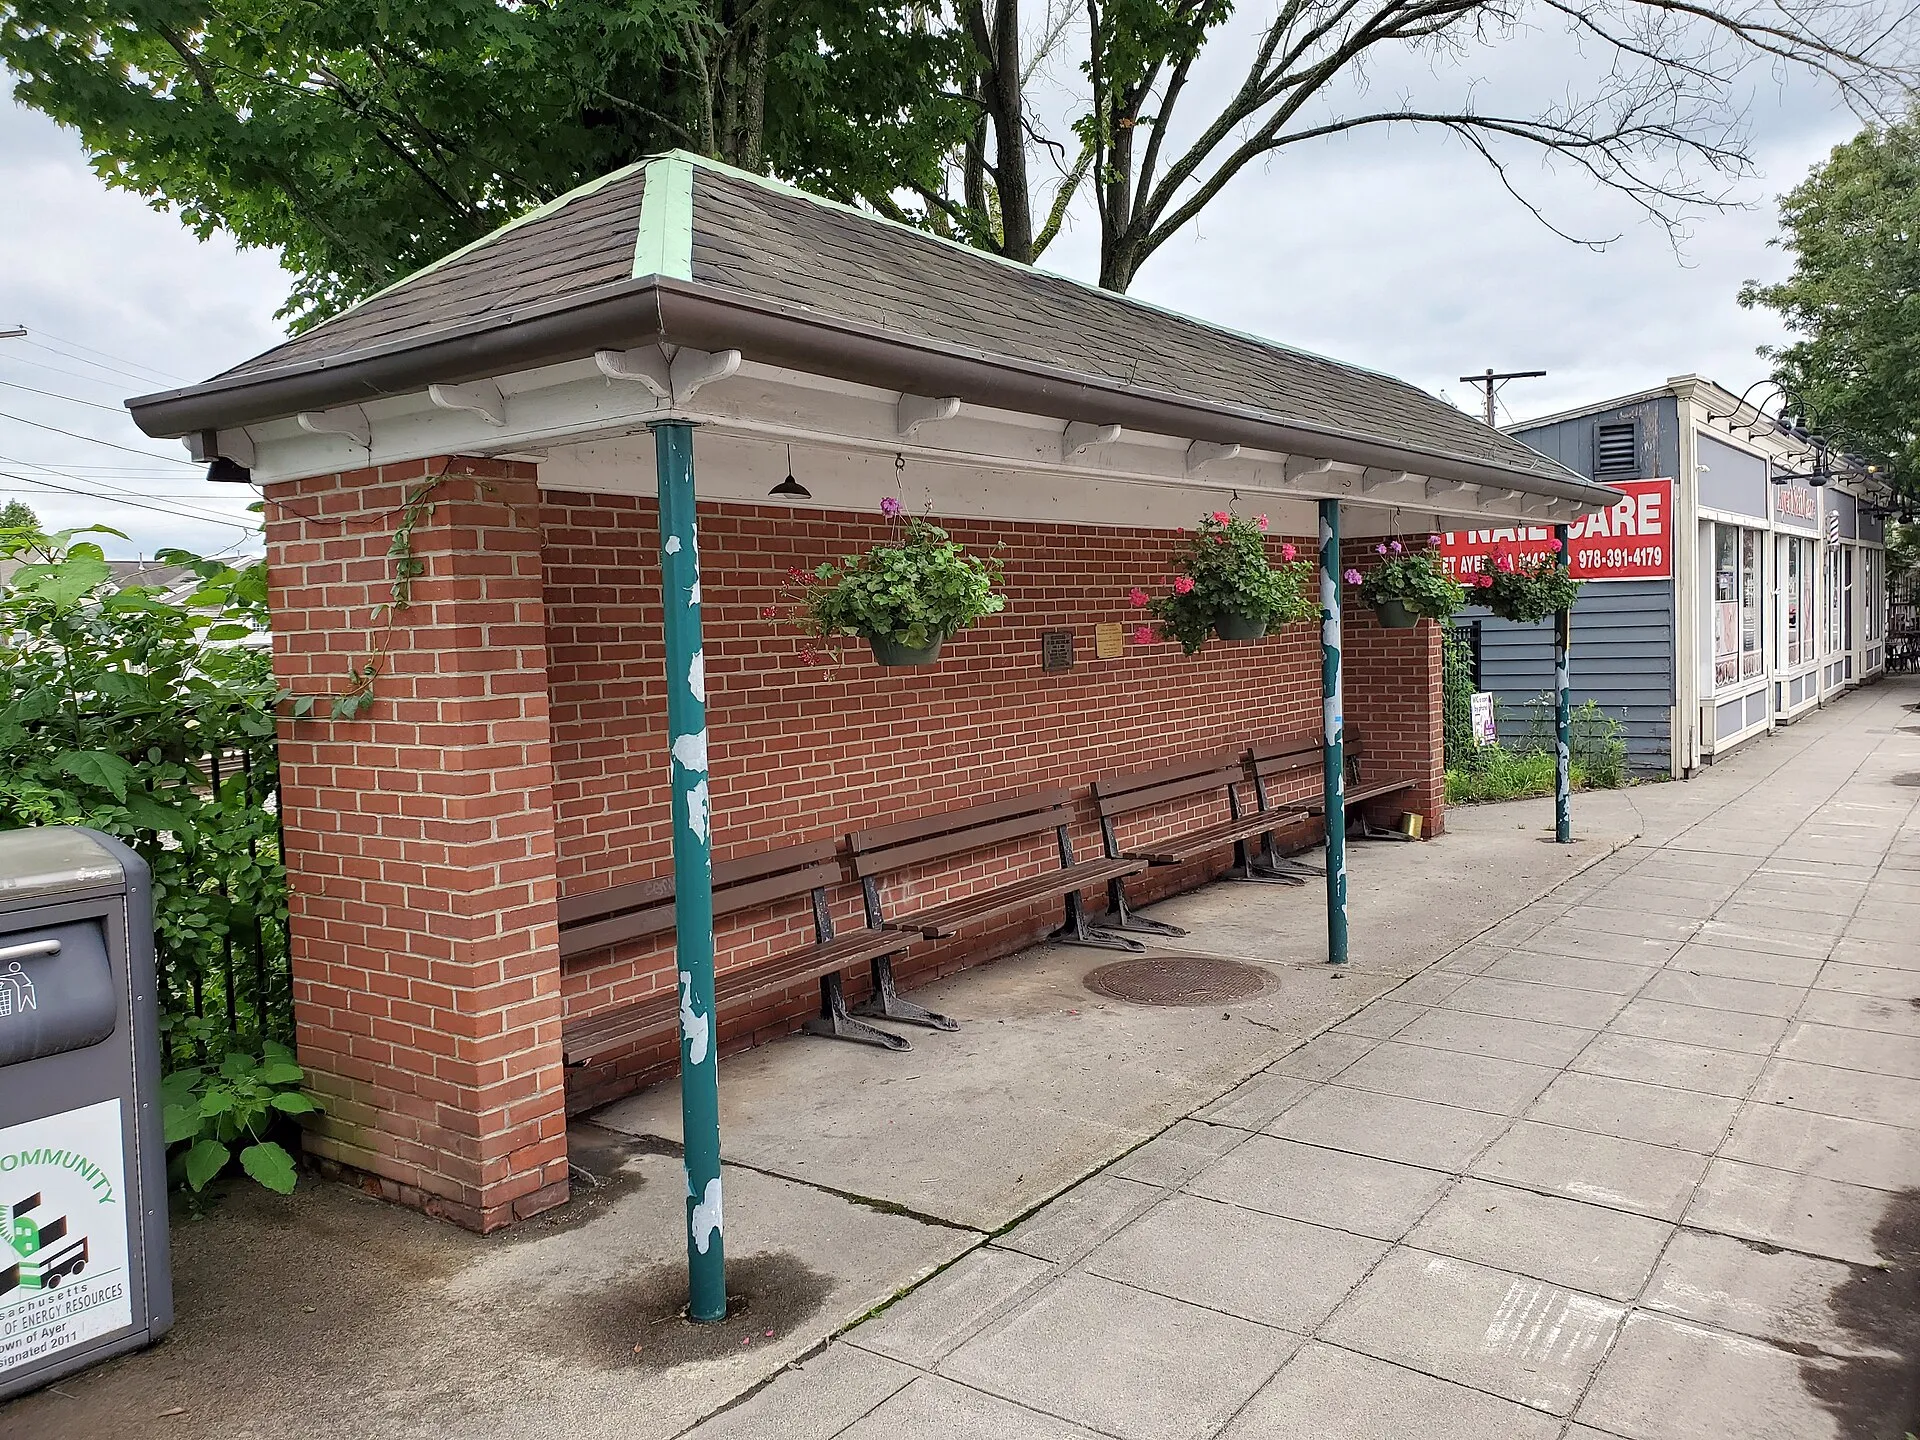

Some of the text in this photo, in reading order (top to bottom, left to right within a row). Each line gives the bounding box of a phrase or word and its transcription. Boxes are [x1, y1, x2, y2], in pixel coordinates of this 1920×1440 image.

[1578, 546, 1662, 569] 978-391-4179
[4, 1282, 123, 1335] OF ENERGY RESOURCES
[26, 1331, 37, 1344] of
[41, 1322, 67, 1338] Ayer
[50, 1331, 77, 1349] 2011
